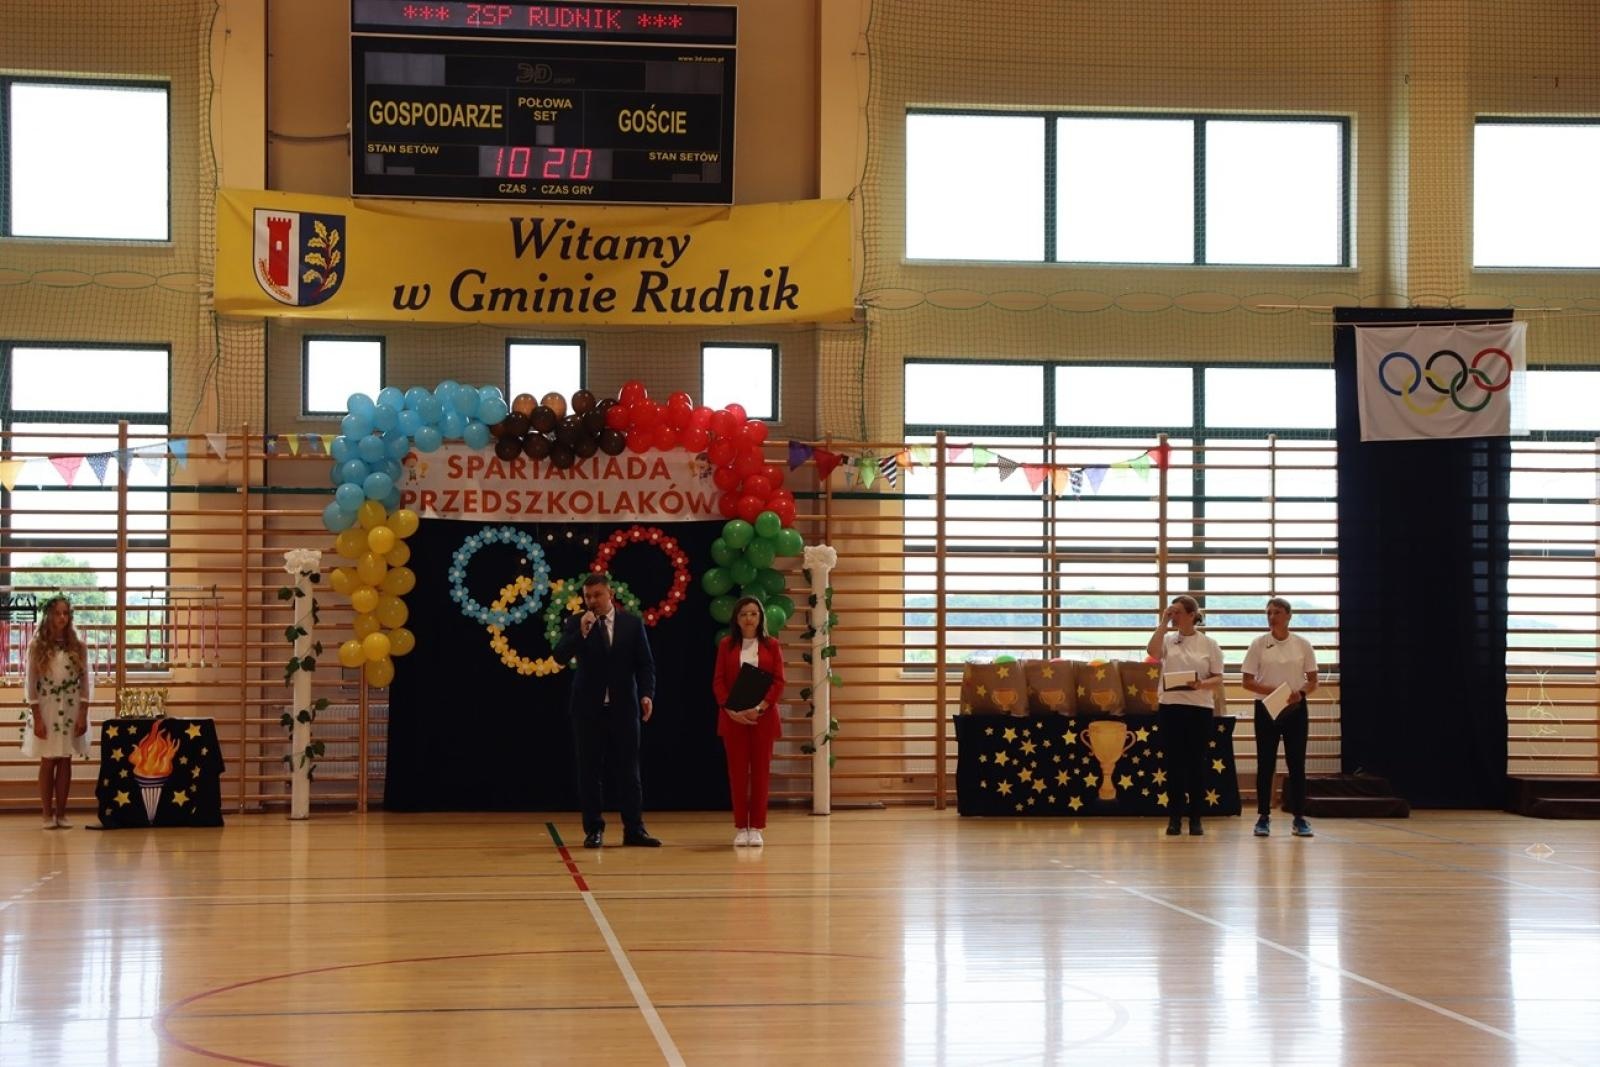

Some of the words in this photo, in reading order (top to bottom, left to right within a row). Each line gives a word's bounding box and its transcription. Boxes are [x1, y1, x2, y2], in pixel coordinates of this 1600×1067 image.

[466, 4, 513, 26] ZSP
[528, 6, 621, 29] RUDNIK
[369, 100, 504, 128] GOSPODARZE
[518, 97, 573, 109] POŁOWA
[533, 111, 558, 121] SET
[618, 104, 687, 134] GOŚCIE
[367, 144, 396, 153] STAN
[399, 144, 439, 154] SETÓW
[649, 152, 677, 161] STAN
[679, 152, 718, 162] SETÓW
[498, 184, 527, 193] CZAS
[541, 185, 569, 195] CZAS
[571, 186, 594, 195] GRY
[510, 217, 691, 268] Witamy
[393, 283, 431, 310] w
[450, 269, 617, 312] Gminie
[632, 266, 799, 313] Rudnik
[447, 454, 671, 480] SPARTAKIADA
[399, 484, 716, 515] PRZEDSZKOLAKÓW
